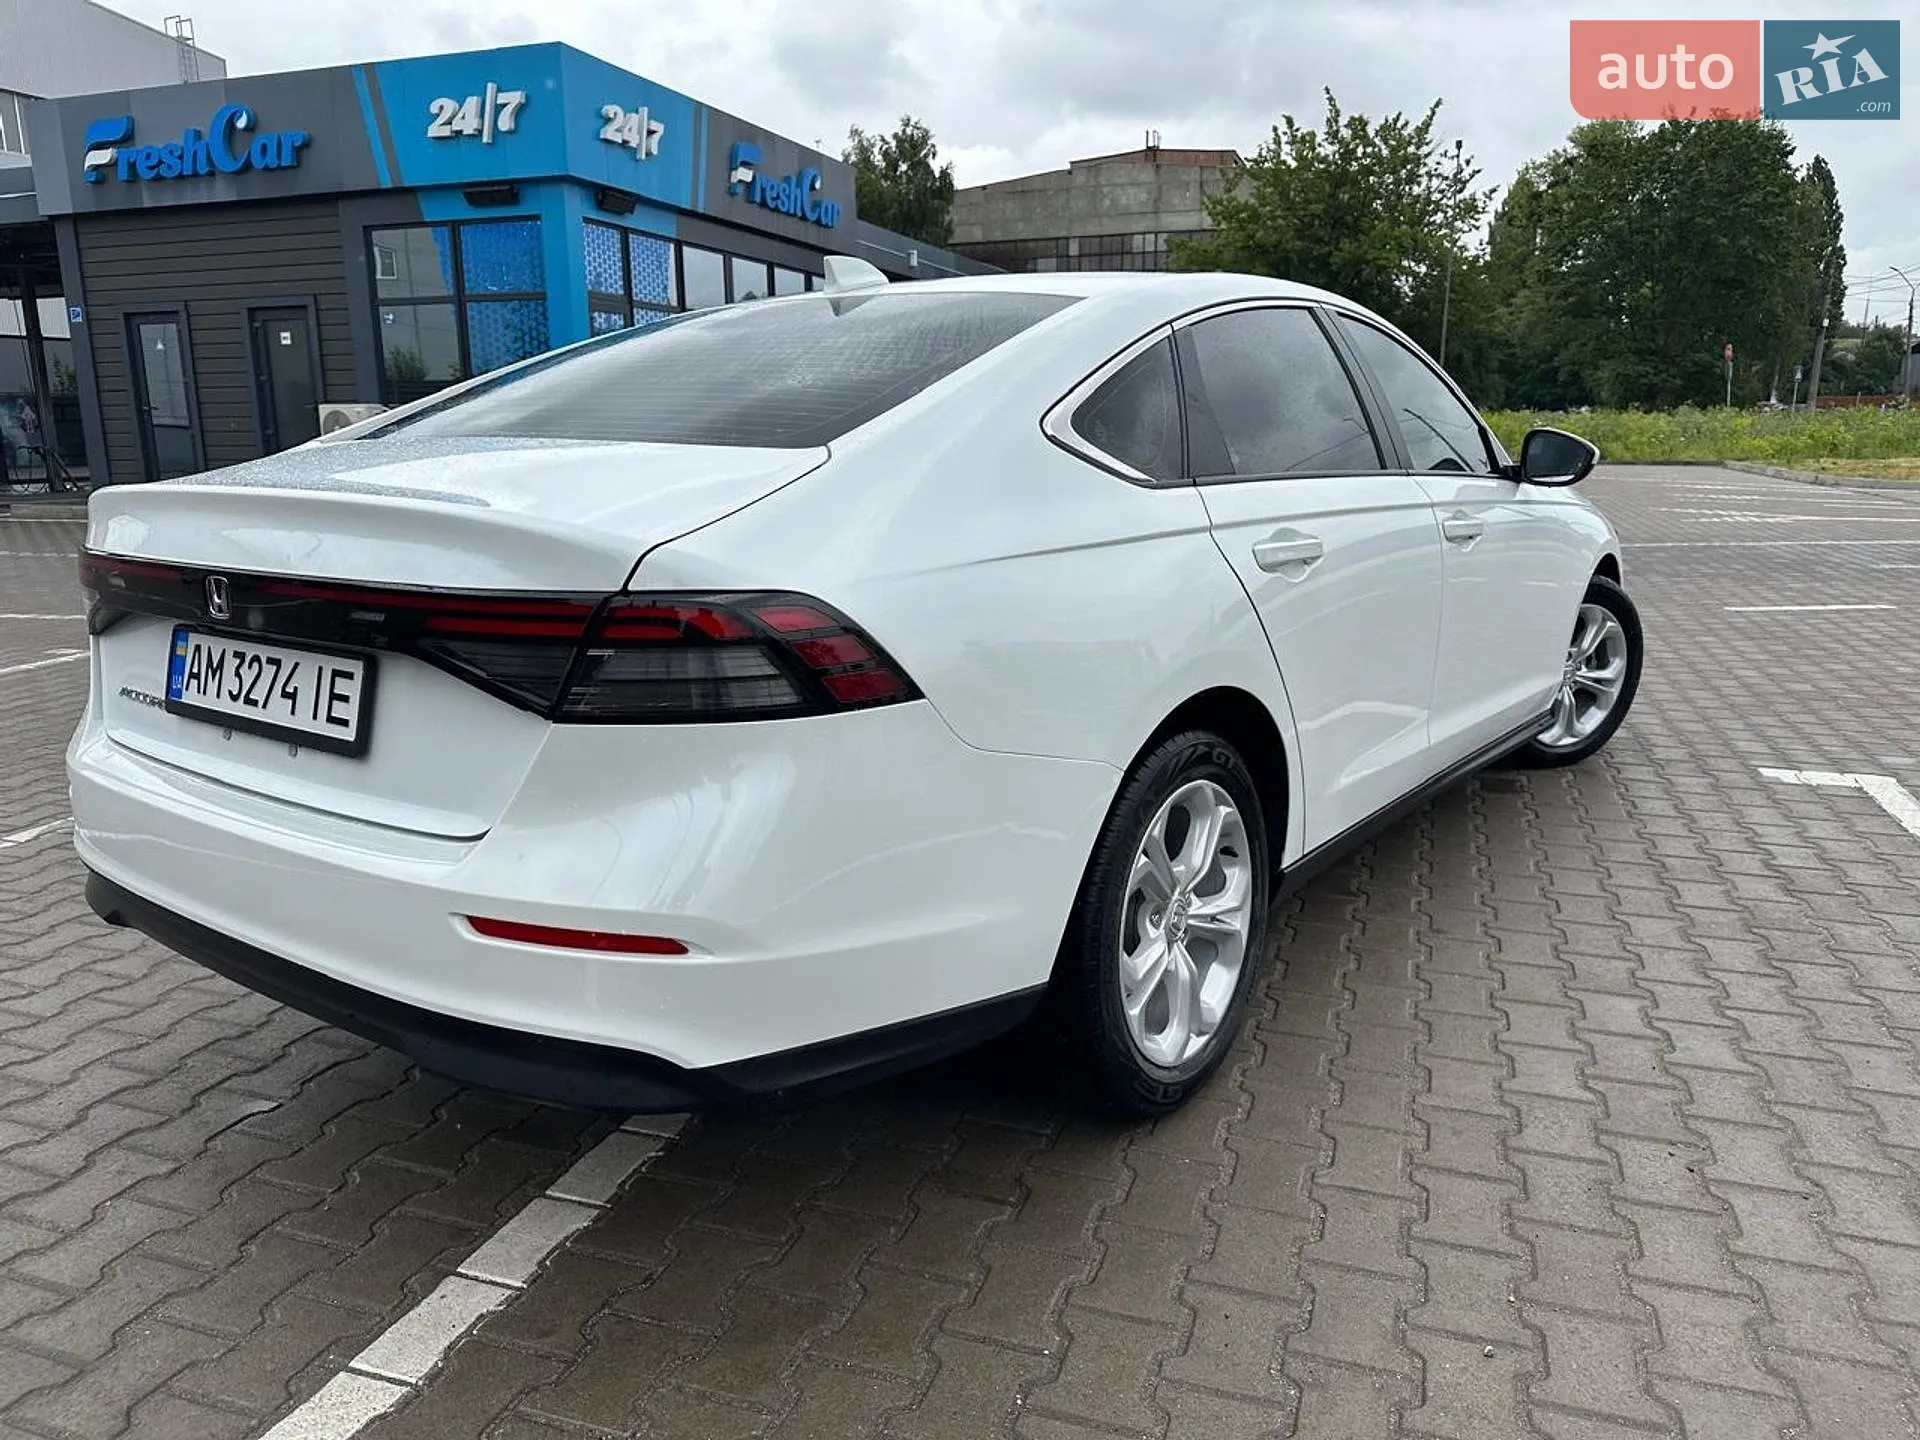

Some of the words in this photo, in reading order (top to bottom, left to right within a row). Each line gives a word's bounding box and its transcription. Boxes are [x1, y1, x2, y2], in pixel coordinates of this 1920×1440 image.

[84, 104, 310, 183] FreshCar
[728, 143, 841, 230] FreshCar
[185, 644, 226, 699] AM
[228, 650, 300, 716] 3274
[312, 665, 355, 728] IE
